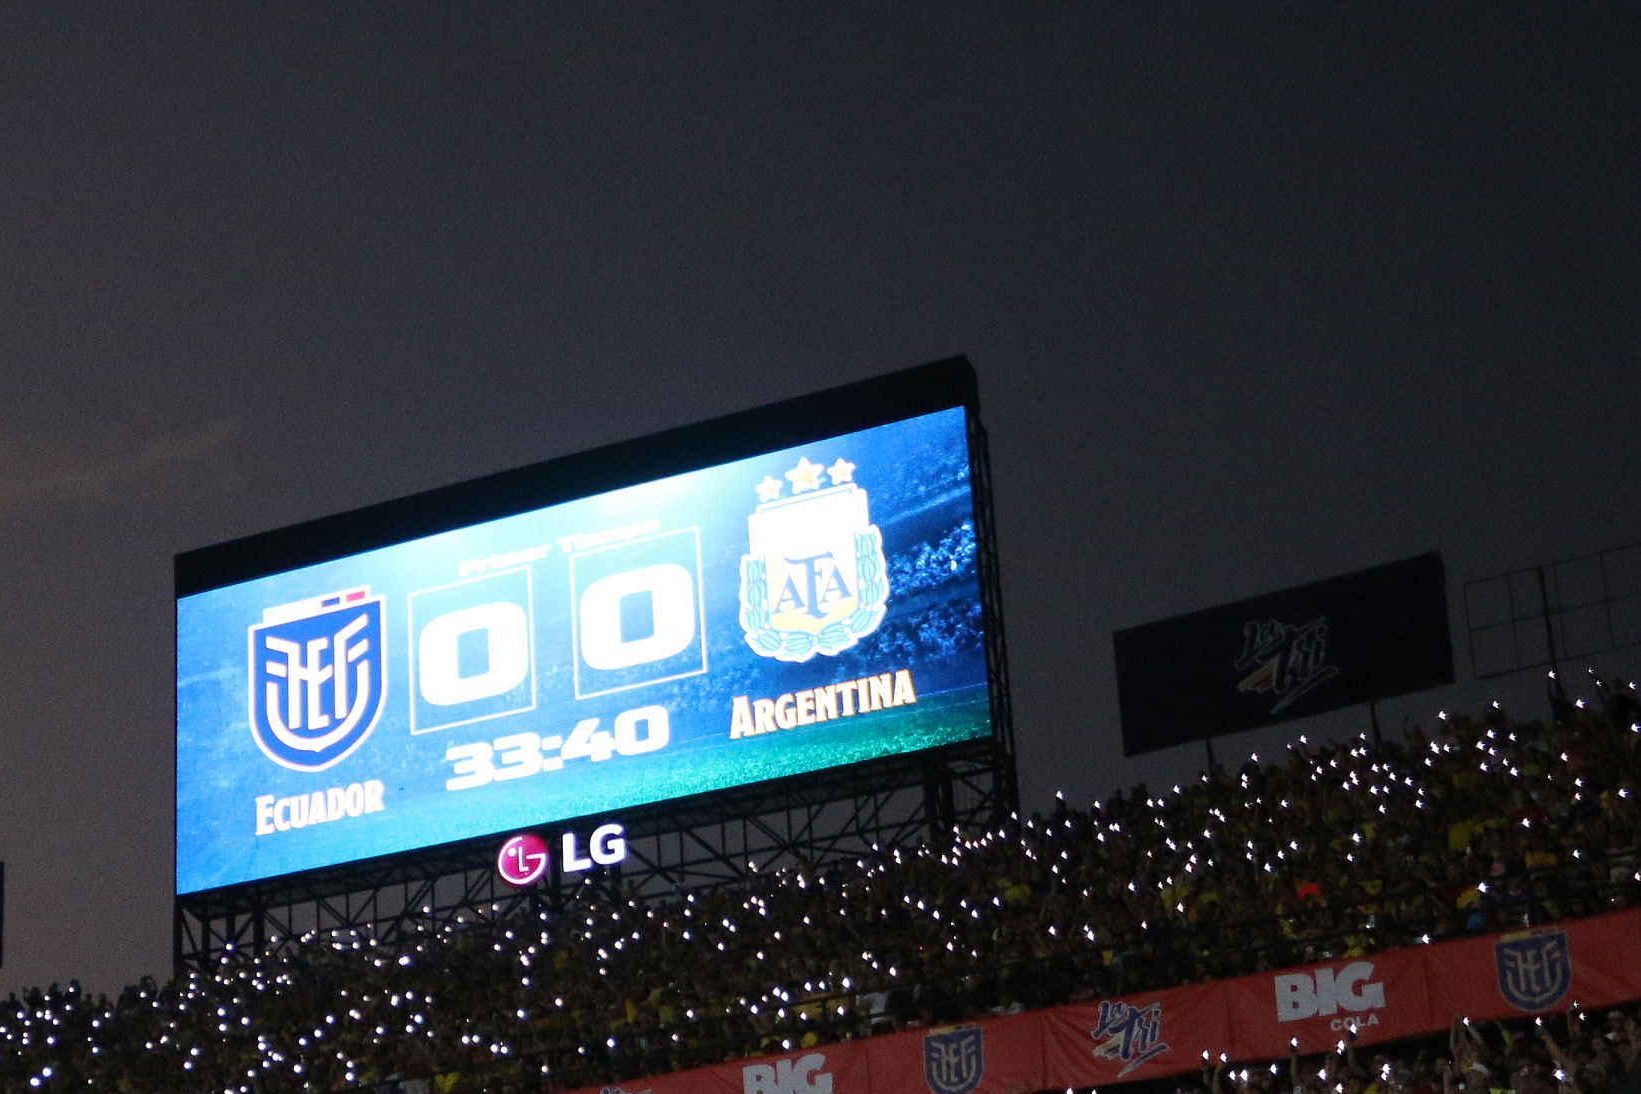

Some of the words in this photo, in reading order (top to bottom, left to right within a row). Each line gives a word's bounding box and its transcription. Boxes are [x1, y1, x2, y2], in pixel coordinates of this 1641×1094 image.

[579, 563, 695, 671] 0
[771, 550, 853, 620] AFA
[419, 601, 529, 706] 0
[729, 668, 917, 740] ARGENTINA
[445, 704, 670, 791] 33:40
[254, 779, 385, 836] ECUADOR
[561, 823, 625, 873] LG
[1275, 962, 1385, 1022] BIG
[1330, 1014, 1379, 1032] COLA
